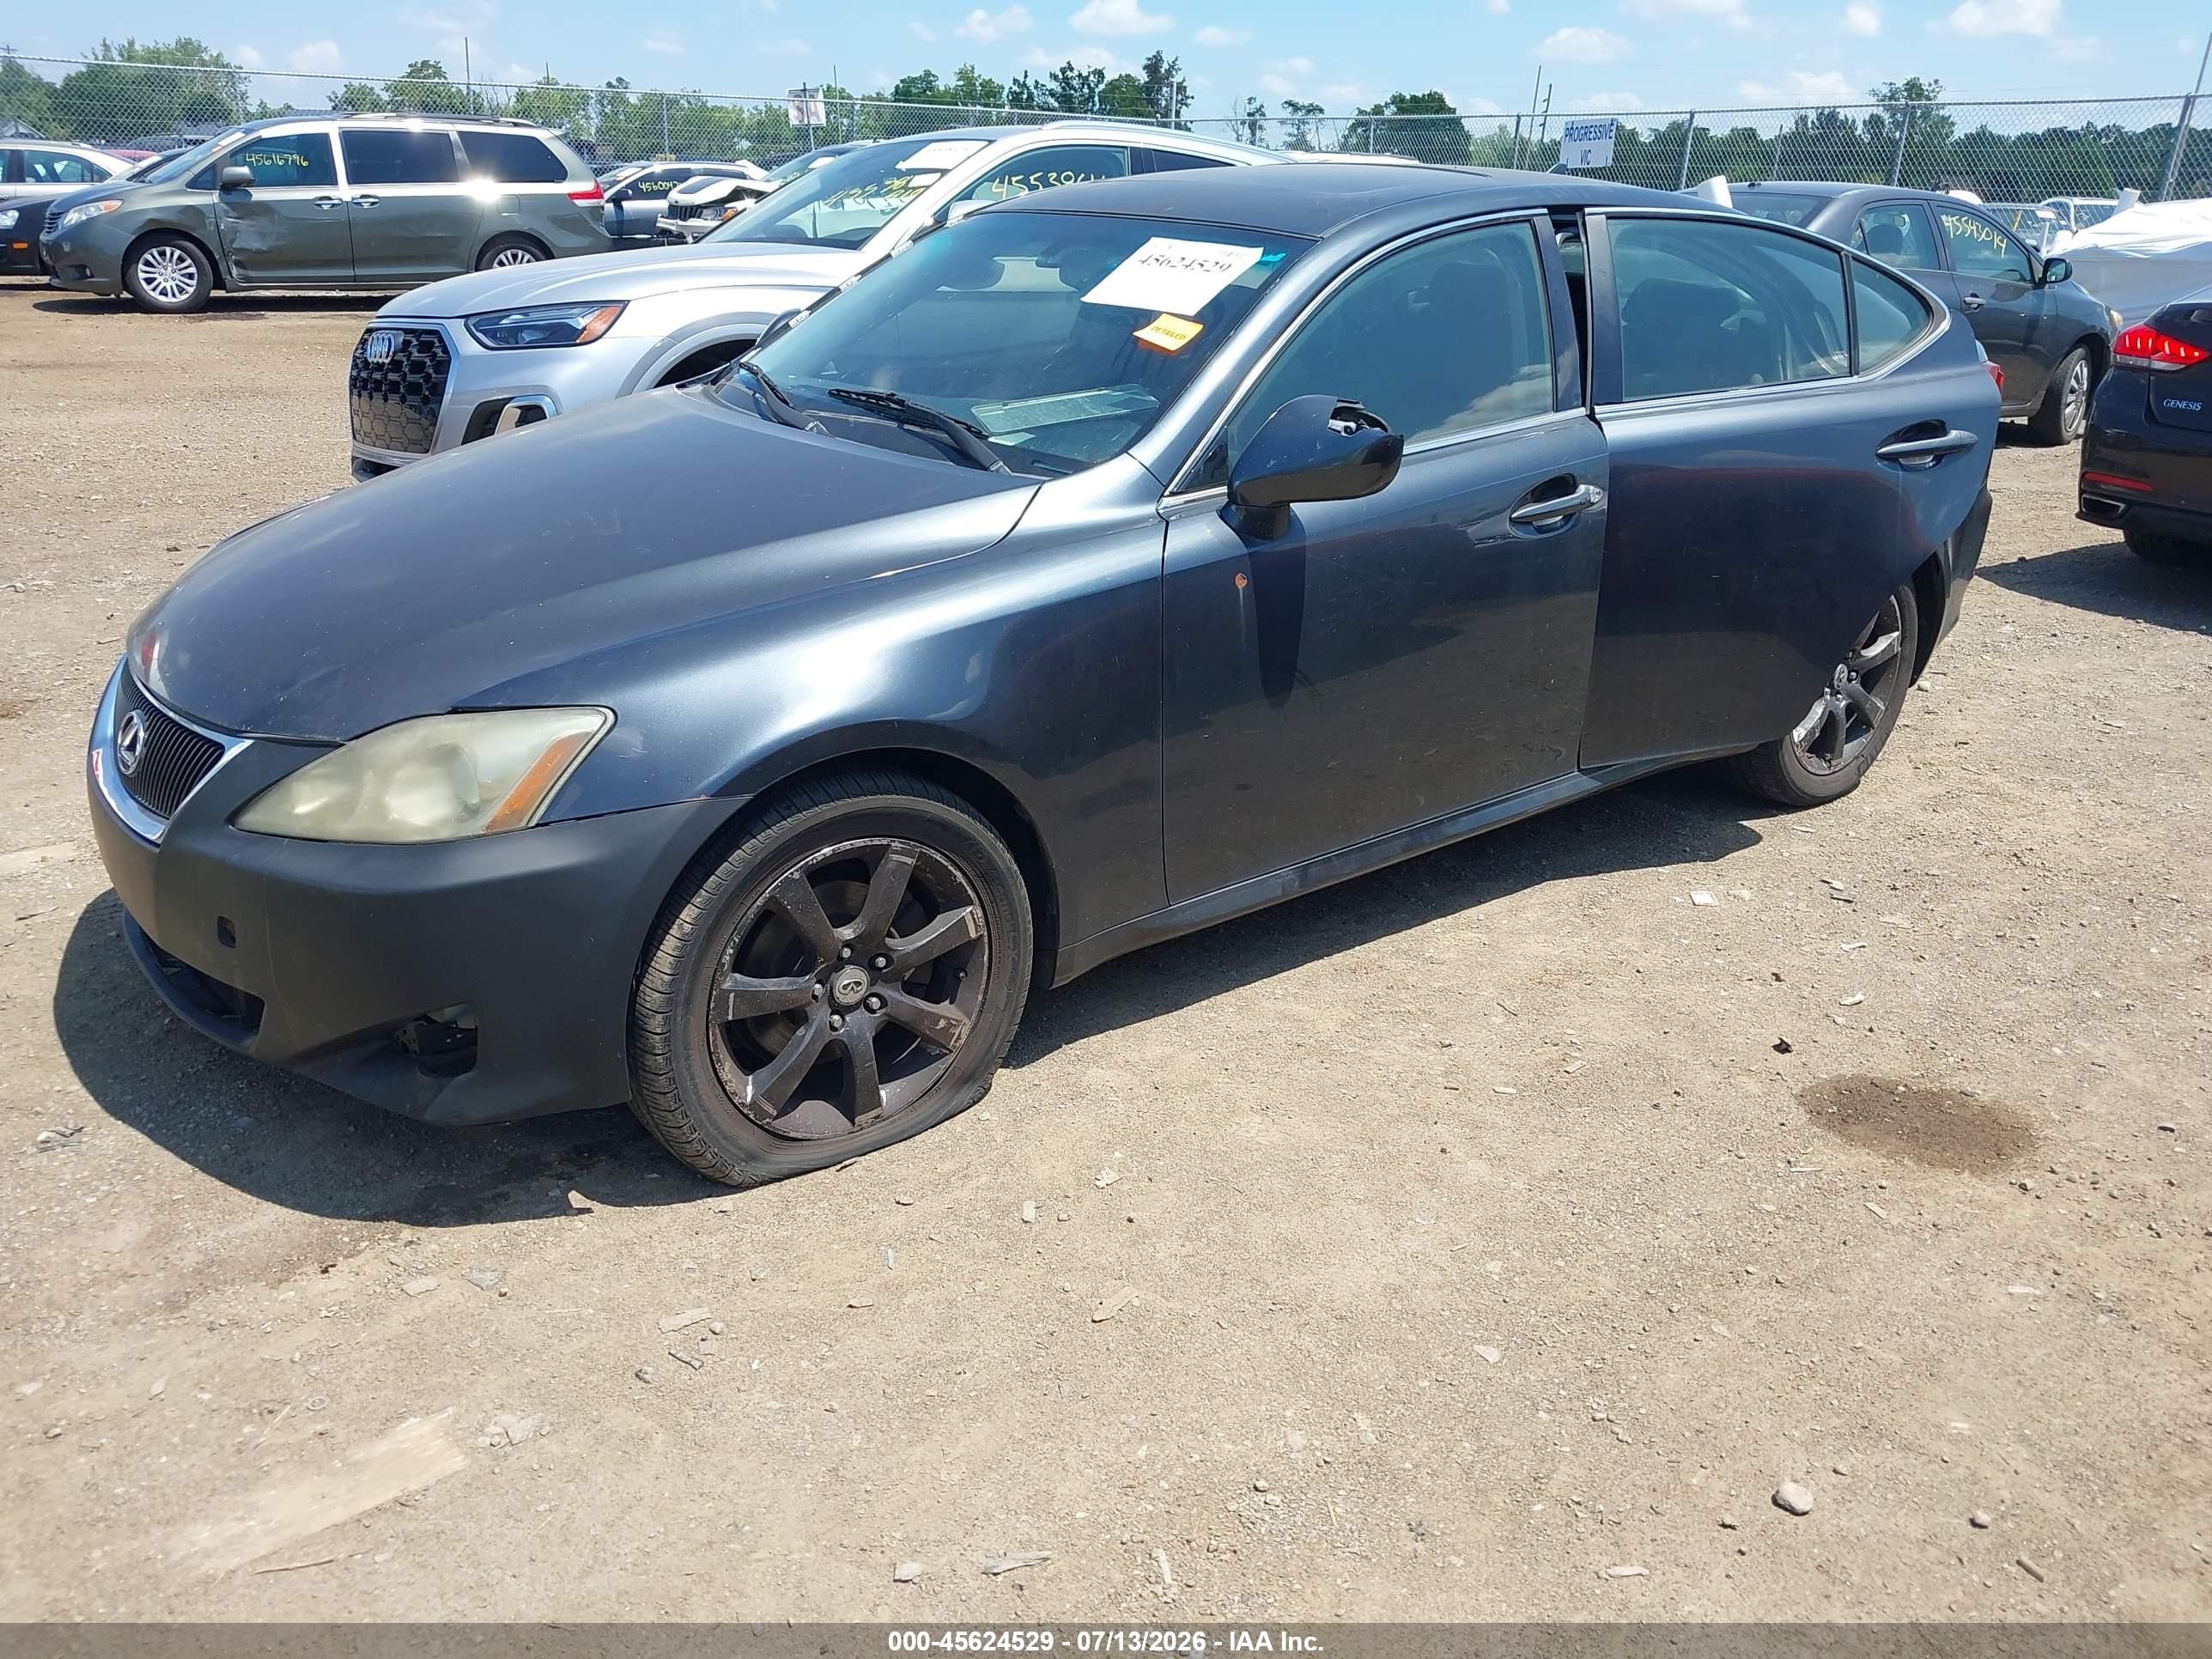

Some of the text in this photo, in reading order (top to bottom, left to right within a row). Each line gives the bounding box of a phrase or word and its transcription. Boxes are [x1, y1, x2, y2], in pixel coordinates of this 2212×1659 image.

[1564, 123, 1614, 143] PROGRESSIVE
[246, 152, 309, 167] 45616796
[1580, 149, 1592, 166] VIC
[1941, 214, 2007, 258] 45543014
[1151, 325, 1188, 340] DETAILED
[2163, 398, 2203, 411] GENESIS
